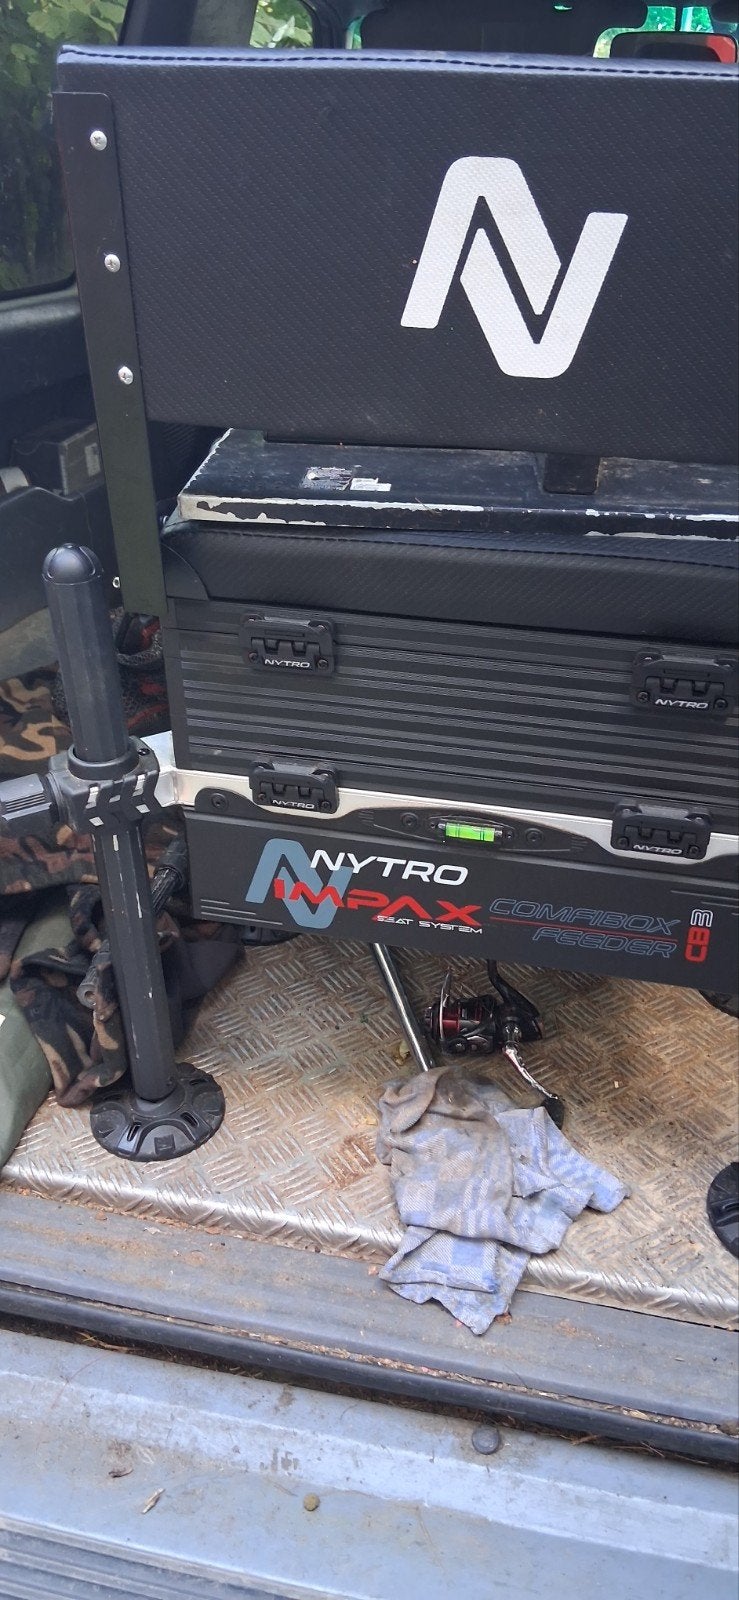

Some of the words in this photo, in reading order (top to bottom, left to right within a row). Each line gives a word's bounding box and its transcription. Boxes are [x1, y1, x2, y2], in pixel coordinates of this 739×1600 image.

[264, 658, 311, 668] NYTRO
[655, 698, 709, 709] NYTRO
[272, 799, 315, 809] NYTRO
[633, 844, 683, 855] NYTRO
[310, 849, 469, 886] NYTRO
[273, 877, 483, 928] IMPAX
[375, 915, 414, 925] SEAT
[418, 920, 483, 934] SYSTEM
[489, 898, 681, 935] COMFIBOX
[532, 927, 677, 958] FEEDER
[684, 909, 714, 962] CB3
